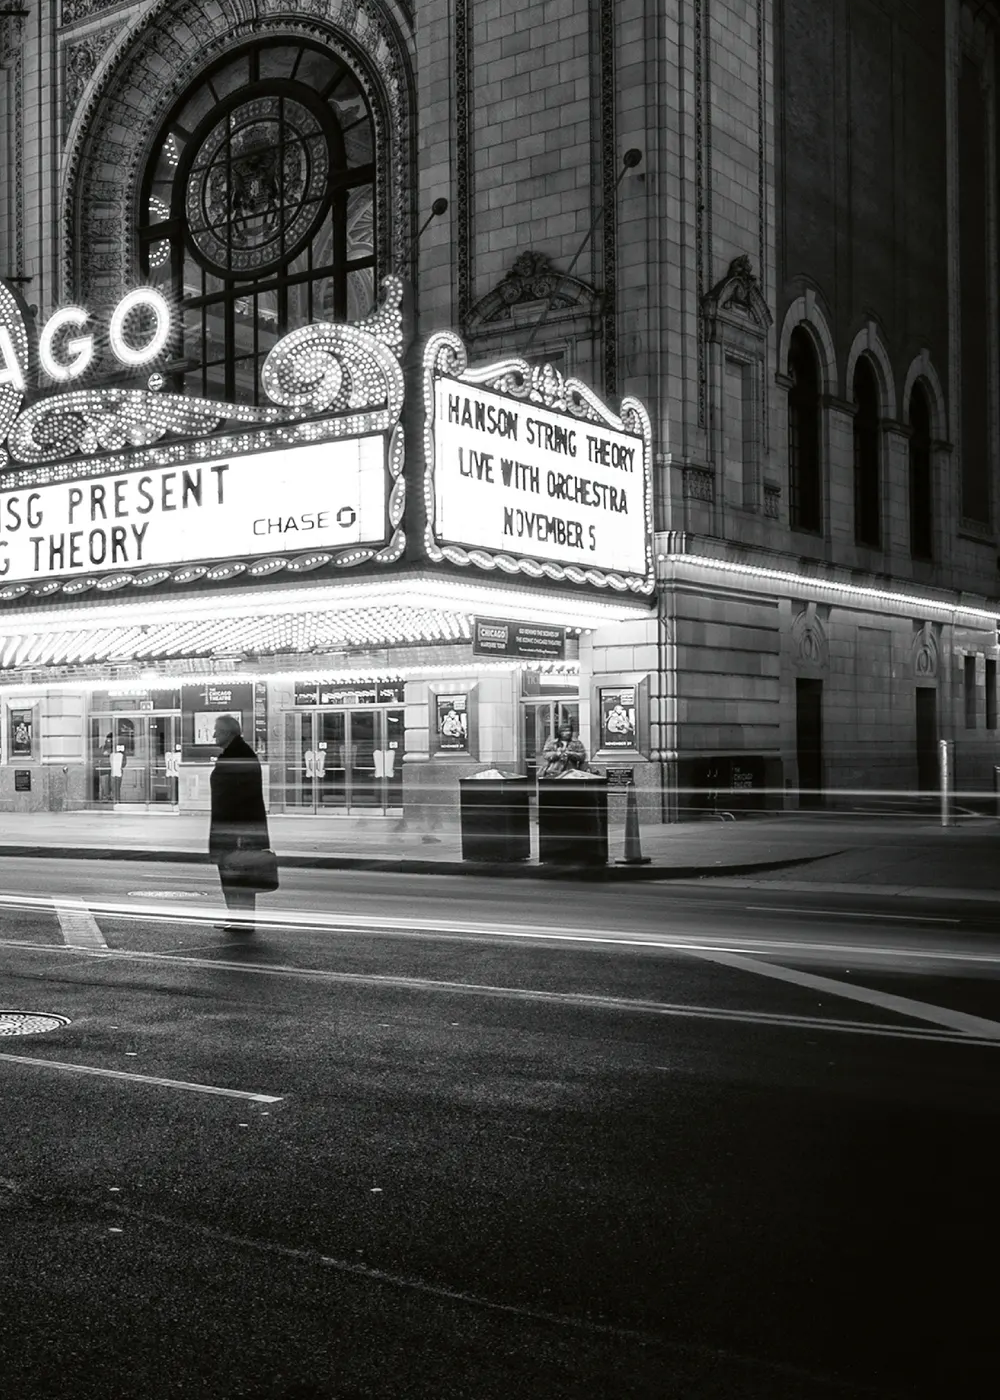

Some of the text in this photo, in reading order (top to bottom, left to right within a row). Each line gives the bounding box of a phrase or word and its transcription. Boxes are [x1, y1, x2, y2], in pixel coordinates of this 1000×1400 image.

[448, 393, 636, 473] HANSON STRING THEORY
[68, 463, 229, 525] PRESENT
[458, 447, 628, 515] LIVE WITH ORCHESTRA
[30, 521, 150, 572] THEORY
[253, 511, 330, 535] CHASE
[504, 506, 596, 551] NOVEMBER 5
